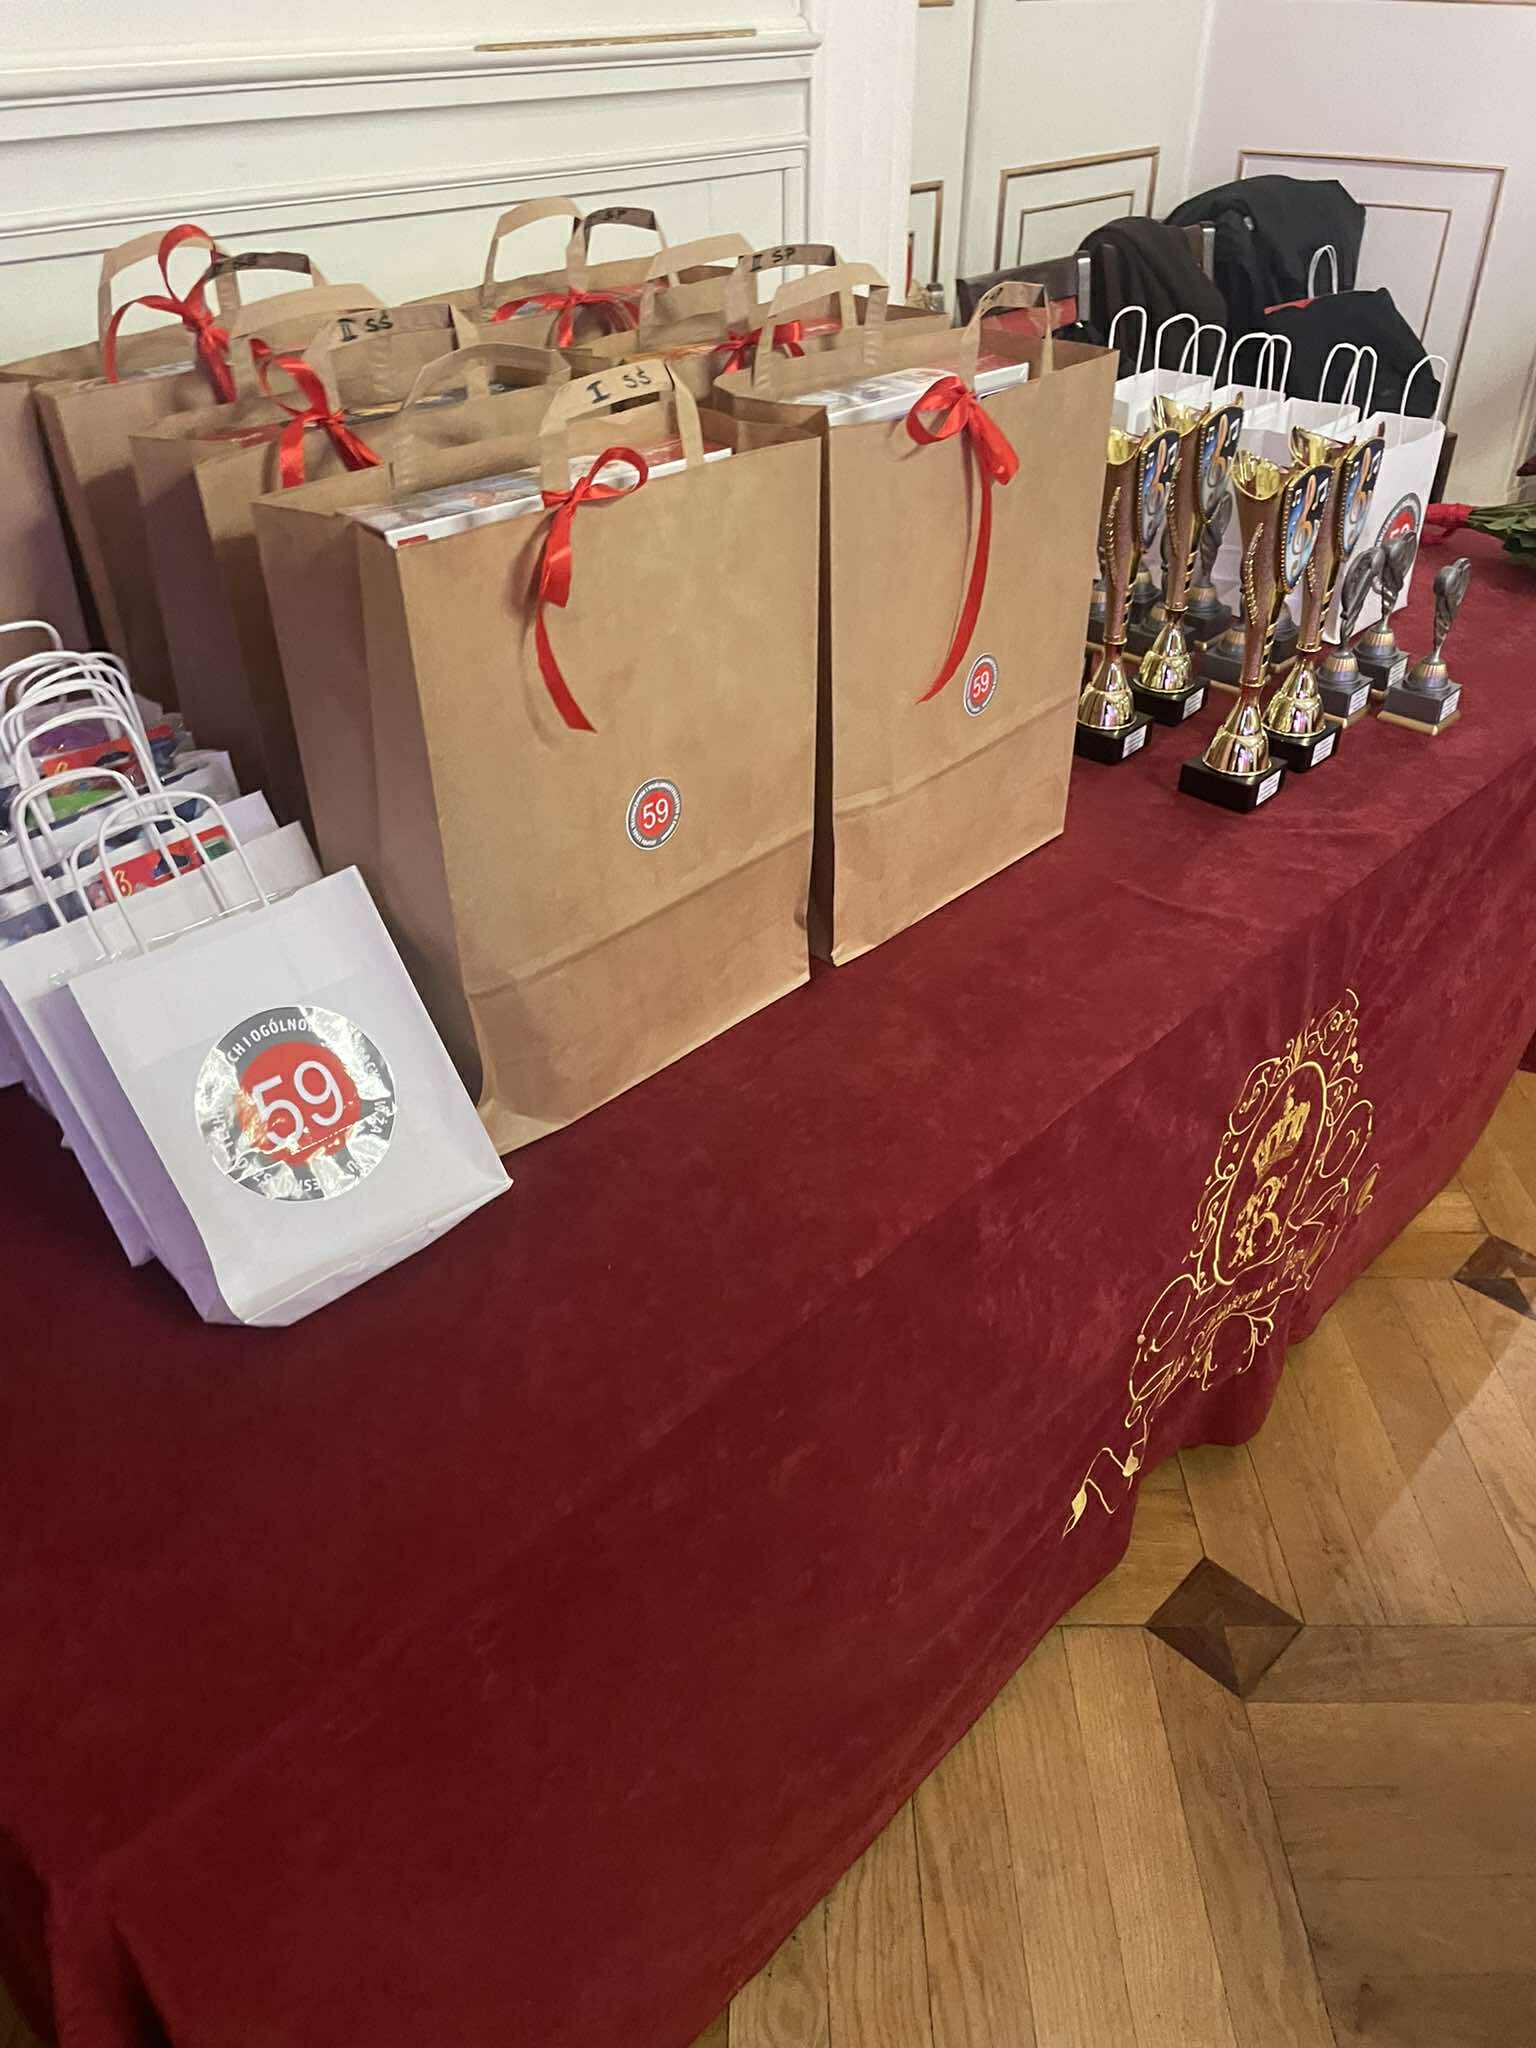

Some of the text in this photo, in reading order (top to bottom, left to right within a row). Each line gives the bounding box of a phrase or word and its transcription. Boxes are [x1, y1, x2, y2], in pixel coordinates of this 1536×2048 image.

[771, 247, 796, 263] SP
[586, 380, 613, 404] I
[972, 671, 989, 698] 59
[643, 798, 669, 829] 59
[251, 1060, 344, 1147] 59
